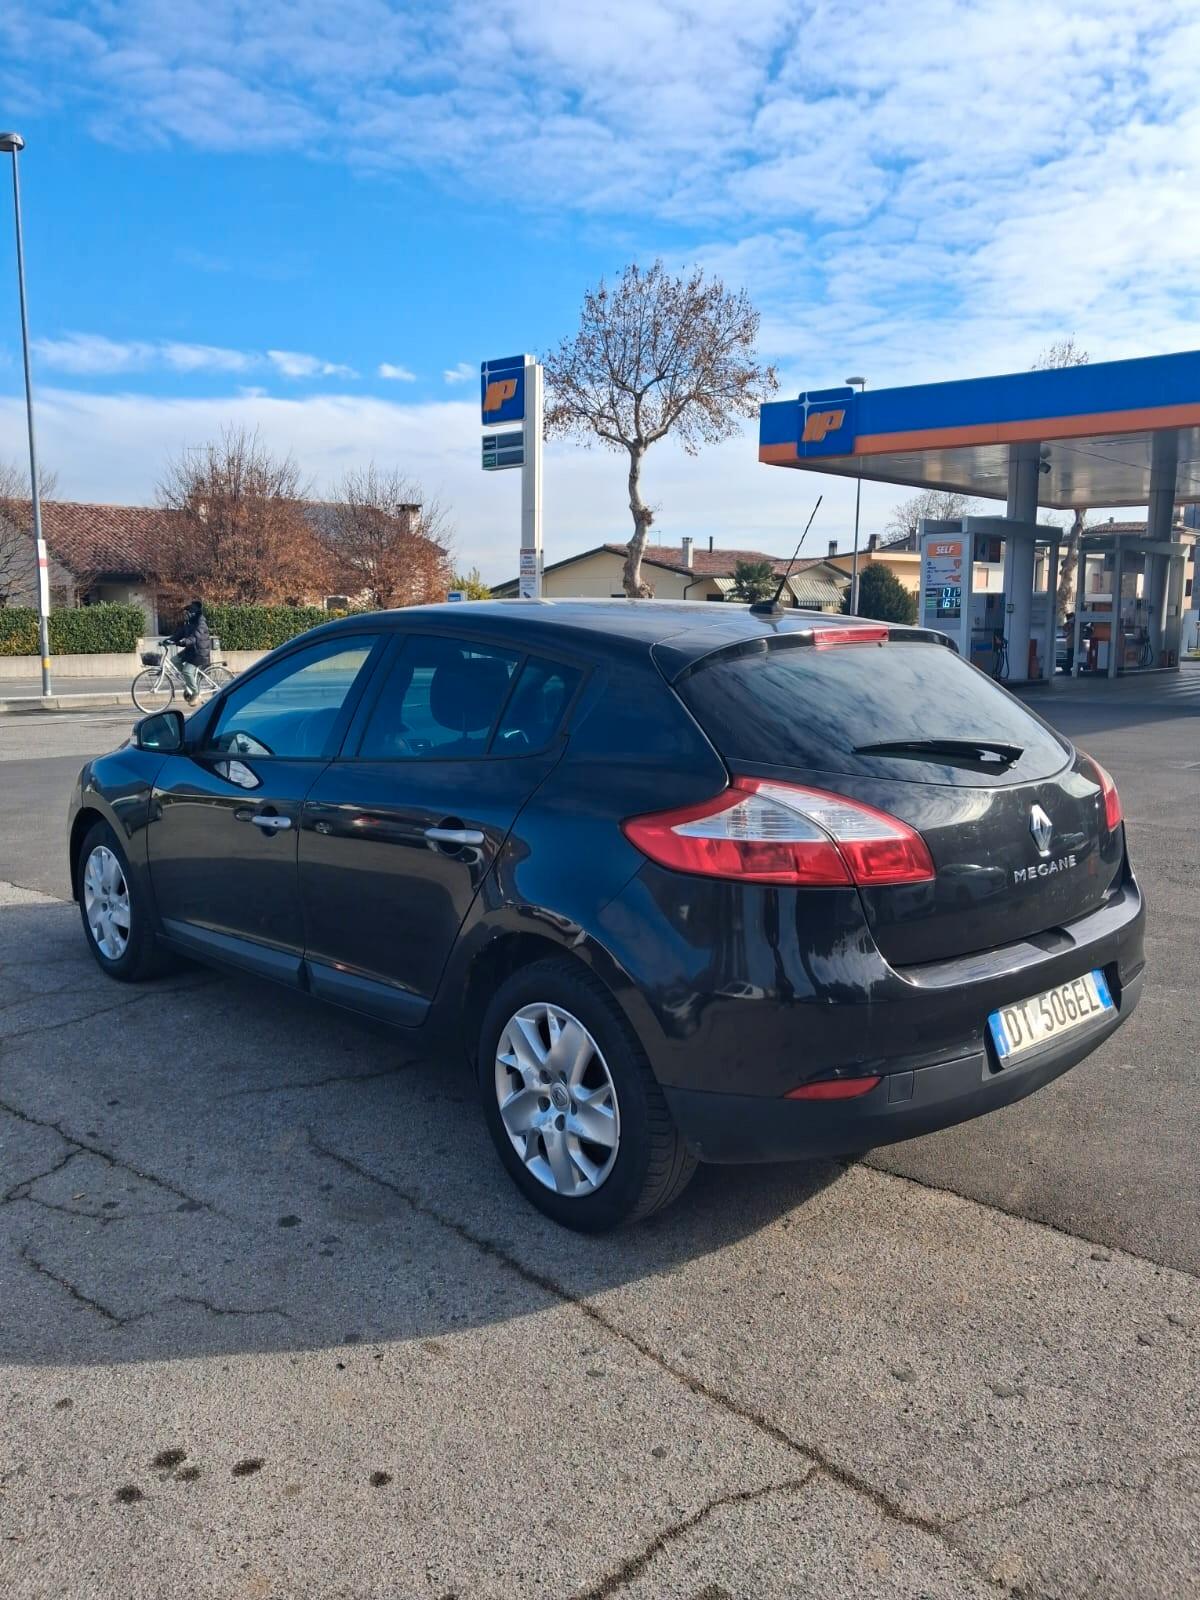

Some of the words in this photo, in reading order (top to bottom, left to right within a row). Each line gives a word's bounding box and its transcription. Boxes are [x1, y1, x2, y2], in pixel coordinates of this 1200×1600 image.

[483, 378, 518, 411] IP
[801, 409, 846, 442] IP
[935, 545, 955, 555] SELF
[1014, 854, 1077, 883] MEGANE
[1002, 1000, 1034, 1048] DT
[1037, 978, 1100, 1032] 506EL
